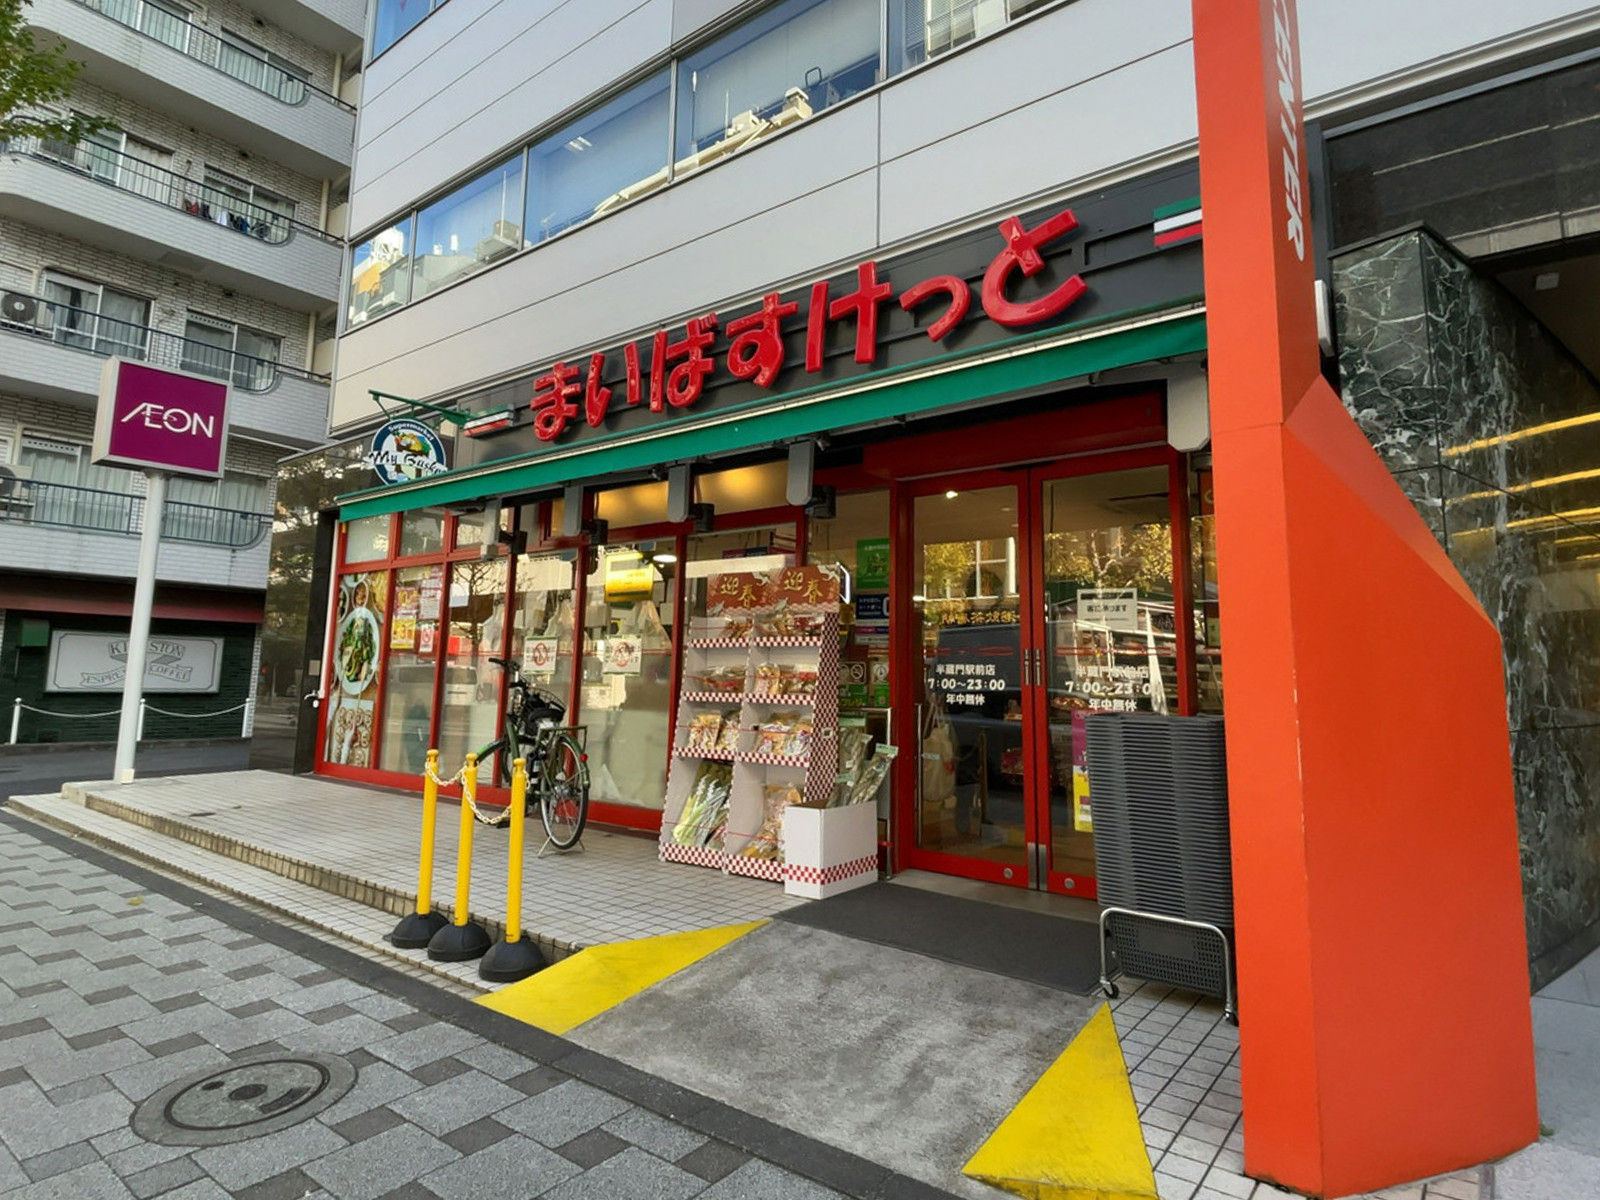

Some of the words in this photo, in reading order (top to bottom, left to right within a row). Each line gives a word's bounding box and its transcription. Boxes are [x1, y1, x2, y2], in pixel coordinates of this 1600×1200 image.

[530, 207, 1089, 442] まいばすけっと
[387, 422, 435, 441] Supermarket
[368, 450, 398, 466] My
[404, 453, 443, 475] Bask
[720, 575, 758, 610] 迎春
[784, 570, 824, 605] 迎春
[110, 641, 184, 657] KISTON
[936, 664, 996, 676] 半蔵門駅前店
[1065, 681, 1153, 695] 7:00～23:0
[946, 693, 986, 706] 年中無休
[1089, 698, 1138, 712] 年中無休
